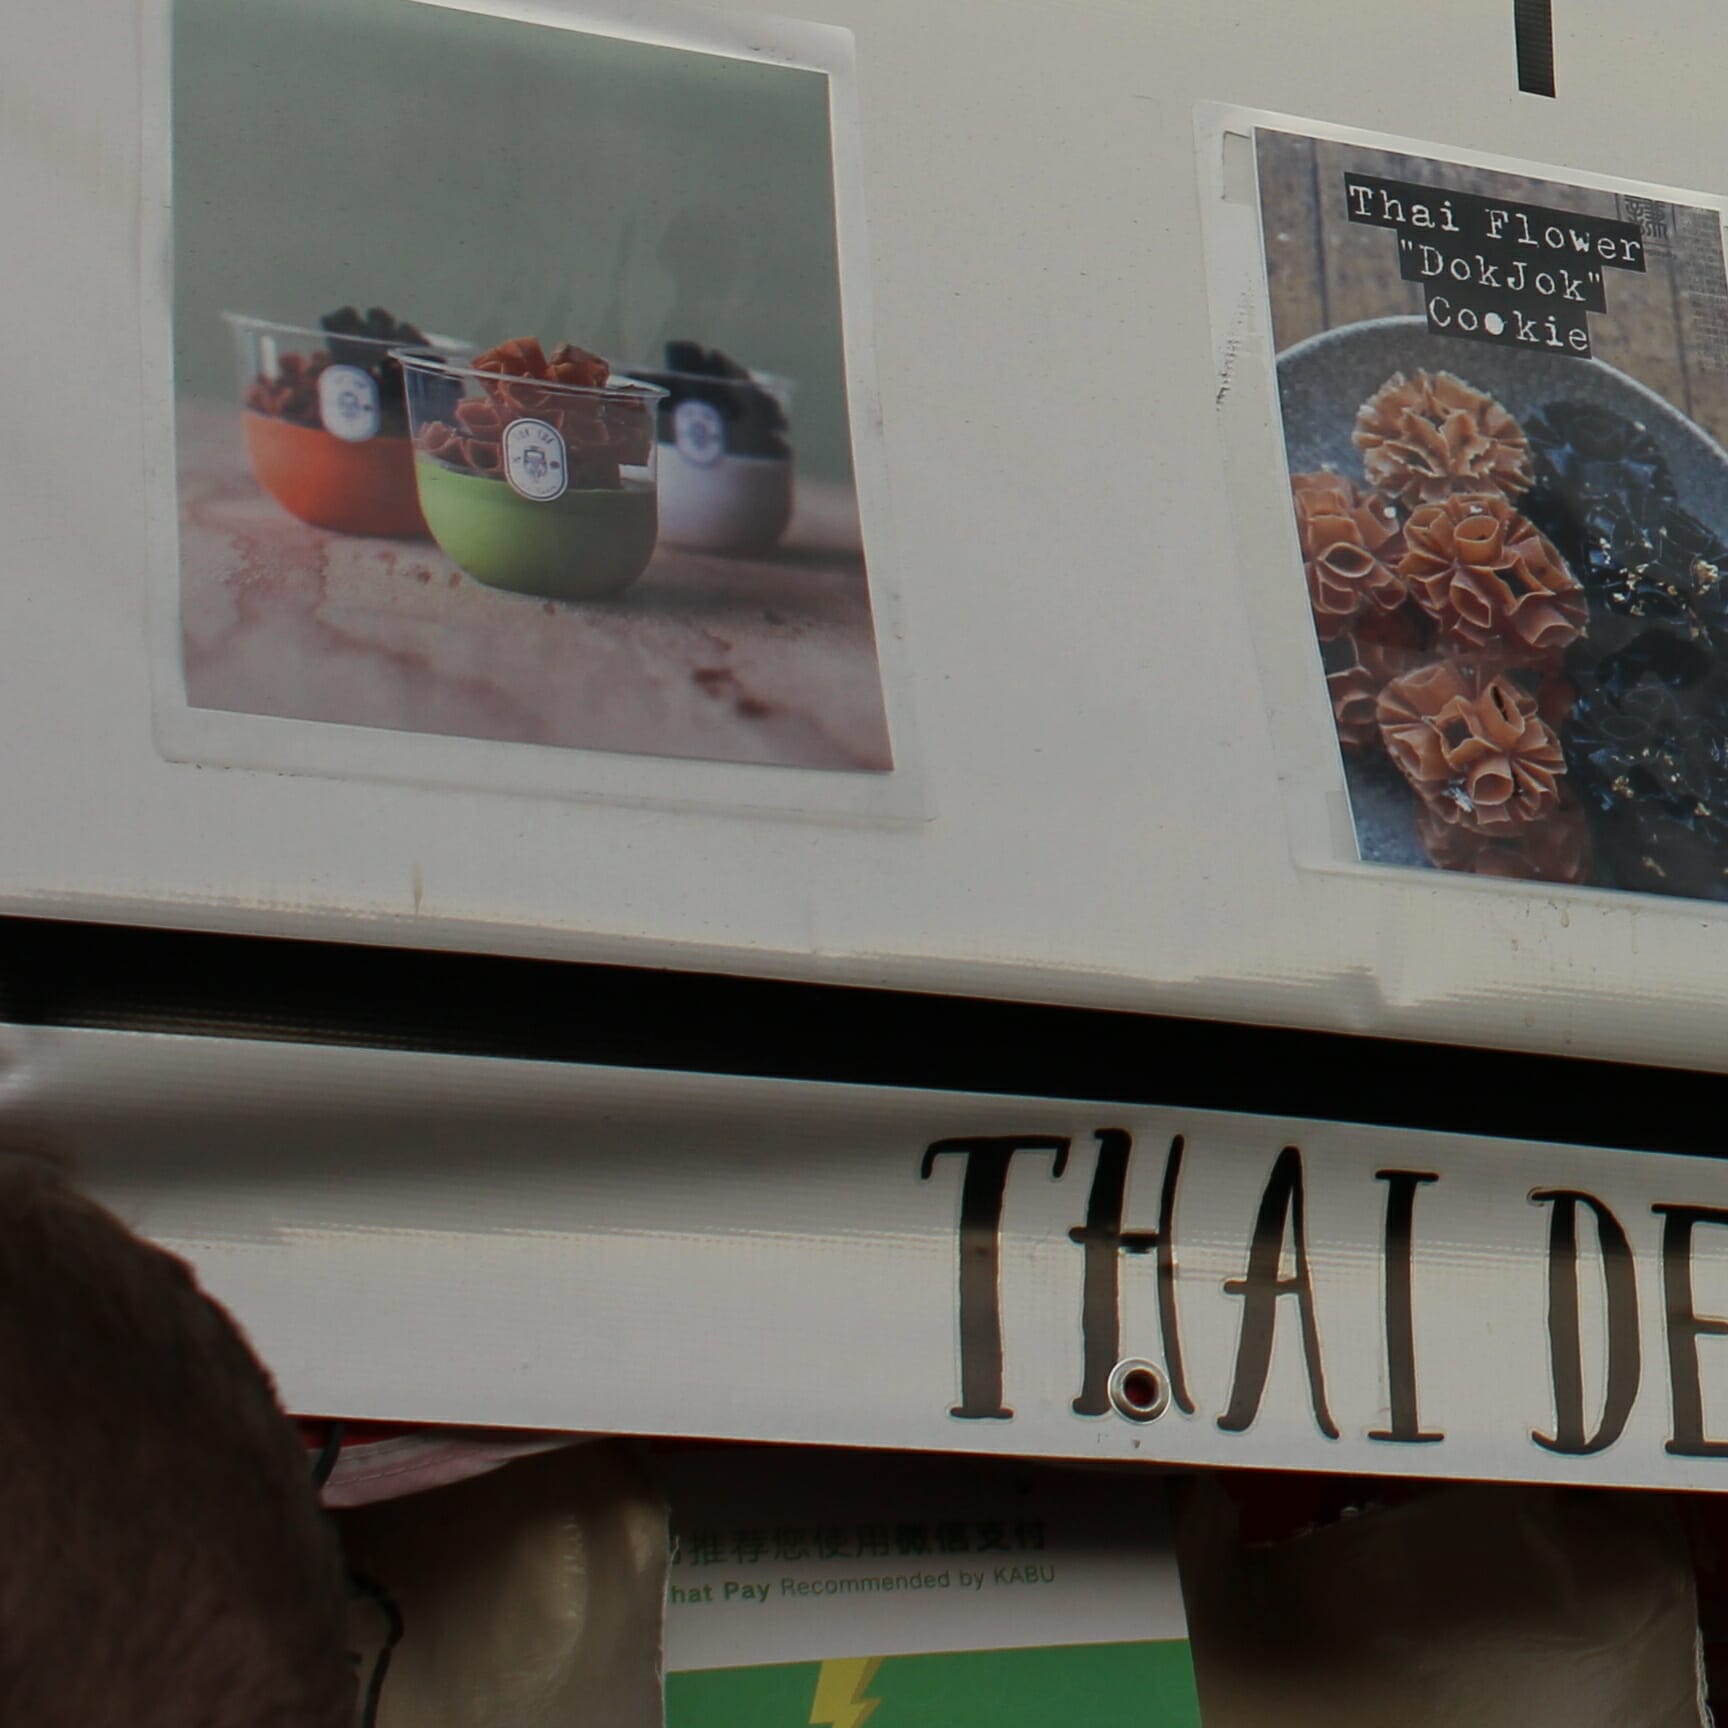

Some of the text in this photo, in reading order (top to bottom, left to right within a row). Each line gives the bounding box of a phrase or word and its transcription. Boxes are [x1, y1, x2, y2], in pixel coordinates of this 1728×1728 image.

[1349, 183, 1461, 232] Thai
[1484, 208, 1641, 262] Flower
[1400, 238, 1601, 303] "DokJok"
[1428, 295, 1589, 351] Cookie
[919, 1127, 1447, 1446] THAI
[672, 1519, 1048, 1567] 推荐您使用微信支付
[670, 1565, 1057, 1605] hat Pay Recommended by KABU
